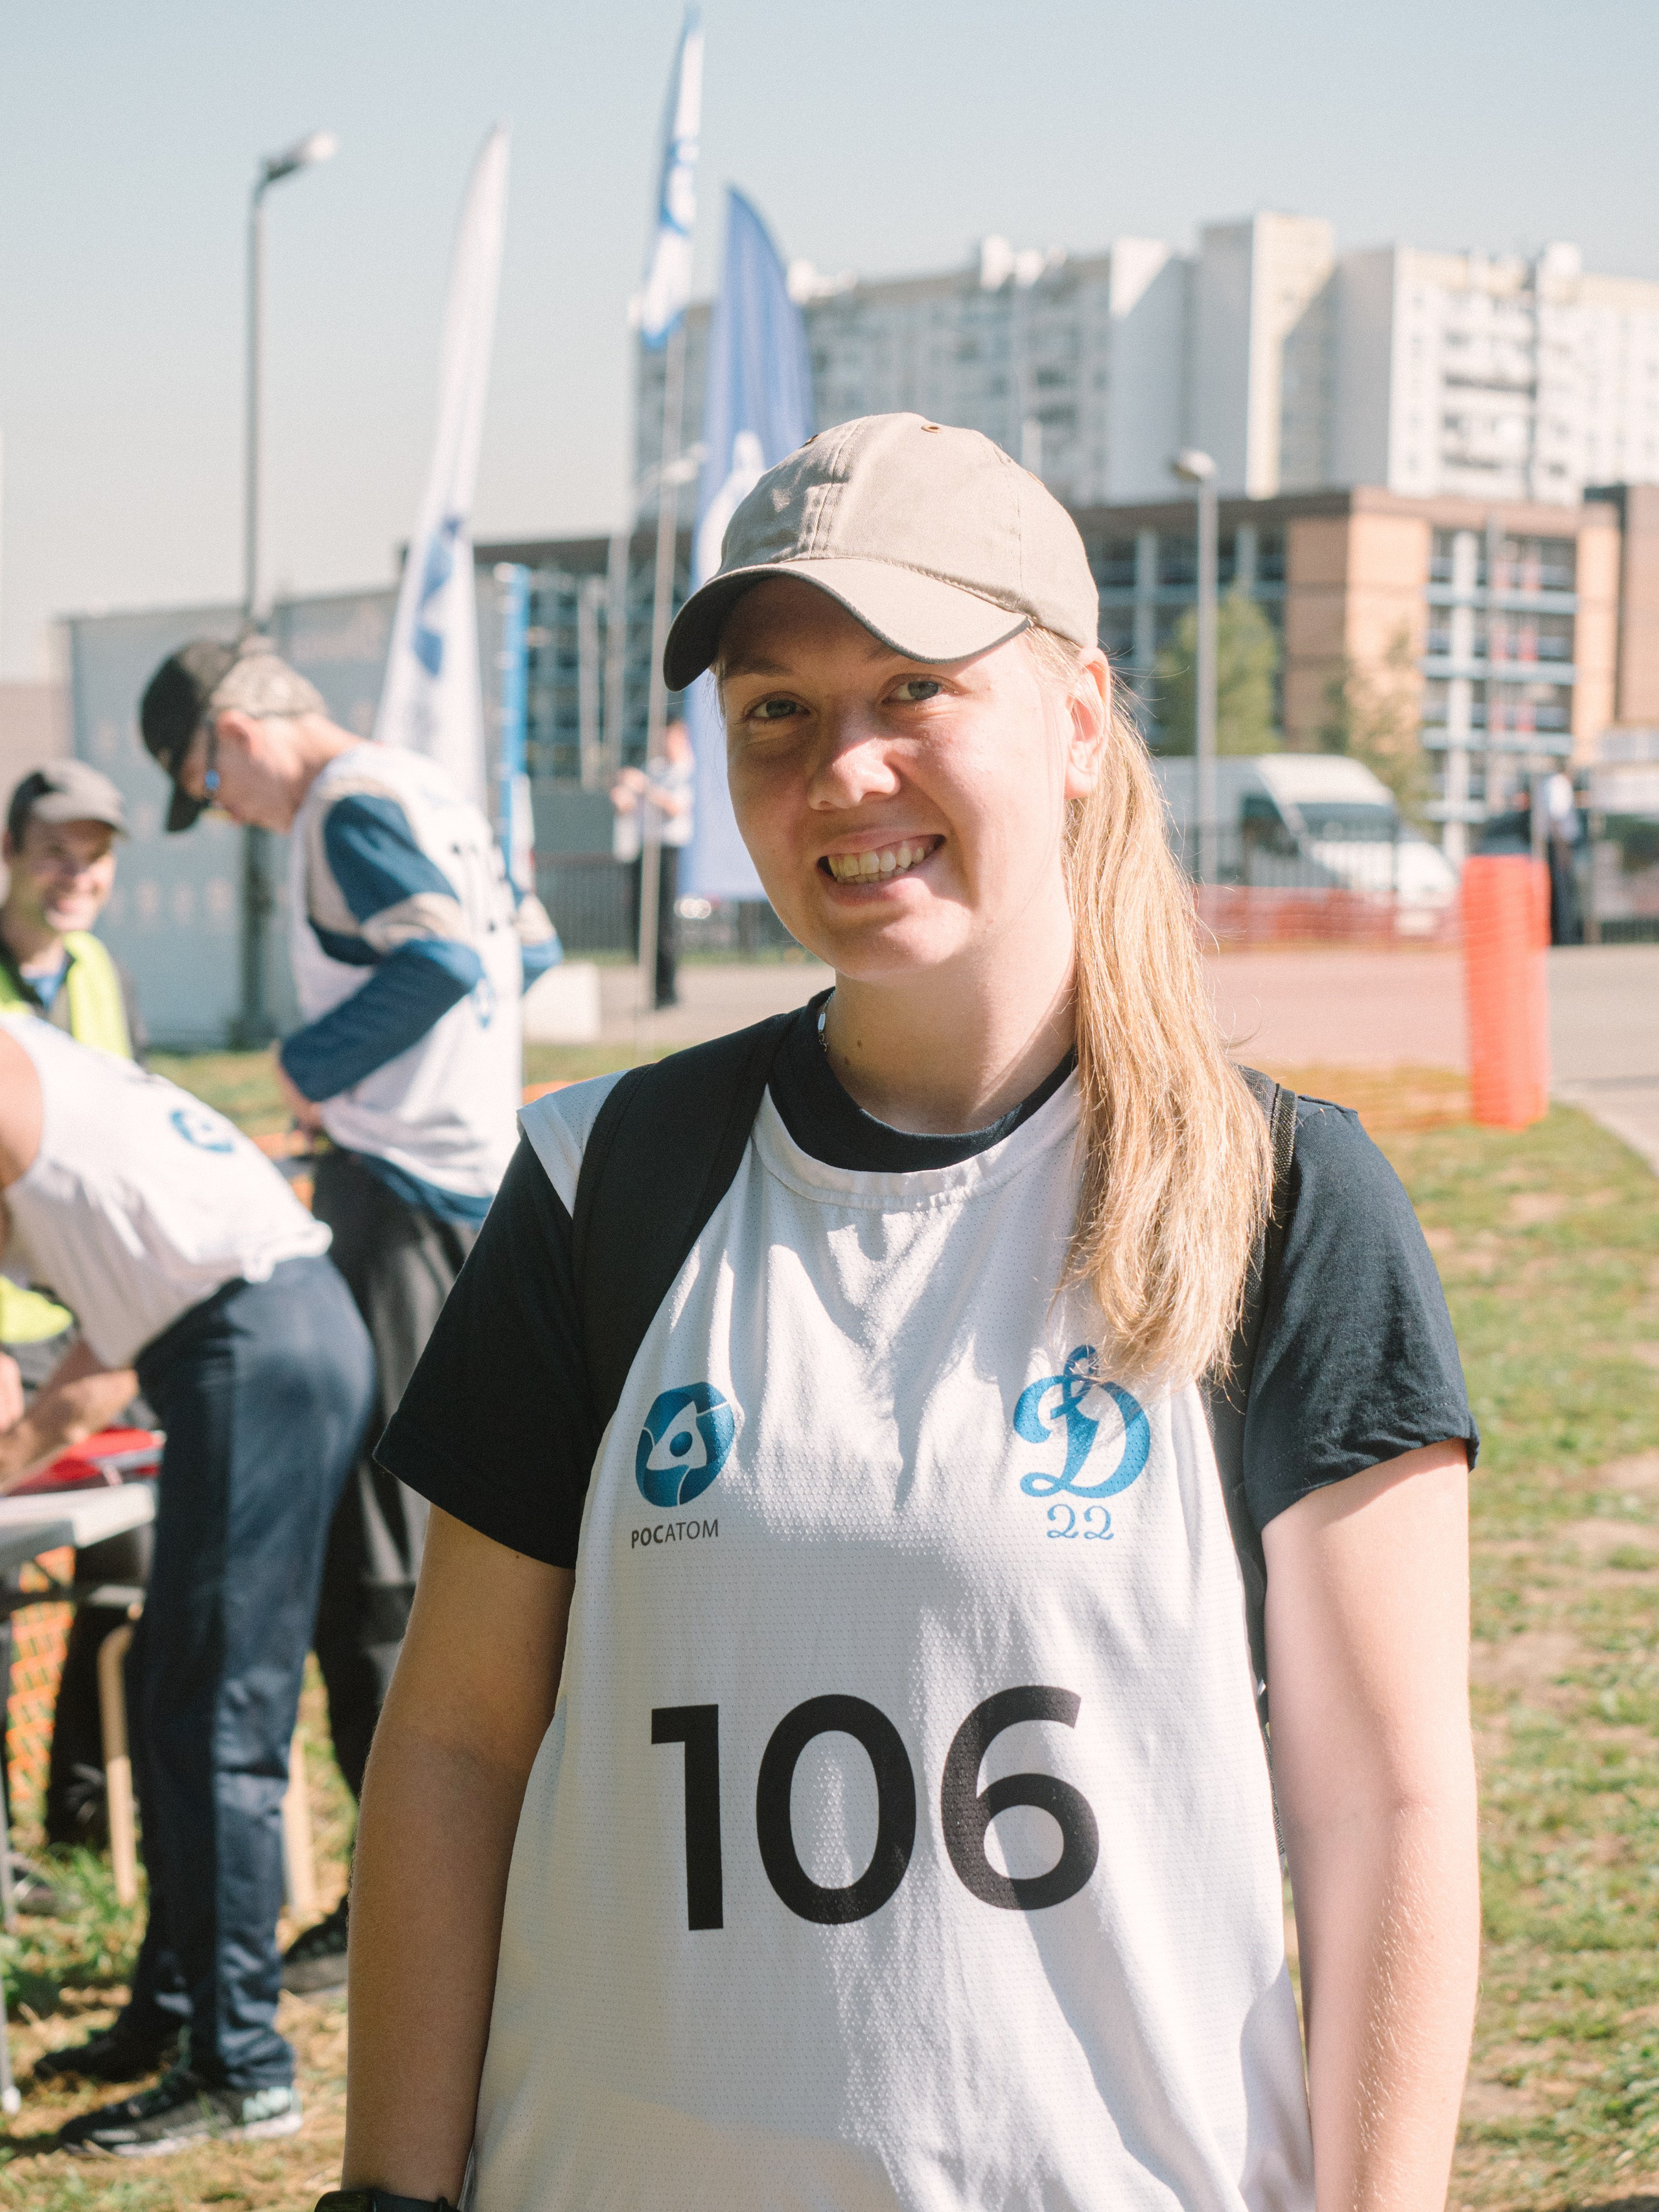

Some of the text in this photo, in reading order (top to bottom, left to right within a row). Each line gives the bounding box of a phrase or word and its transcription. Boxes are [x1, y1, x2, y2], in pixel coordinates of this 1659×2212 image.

[631, 1519, 719, 1549] РОСАТОМ
[1047, 1504, 1115, 1541] 22
[651, 1685, 1100, 1931] 106
